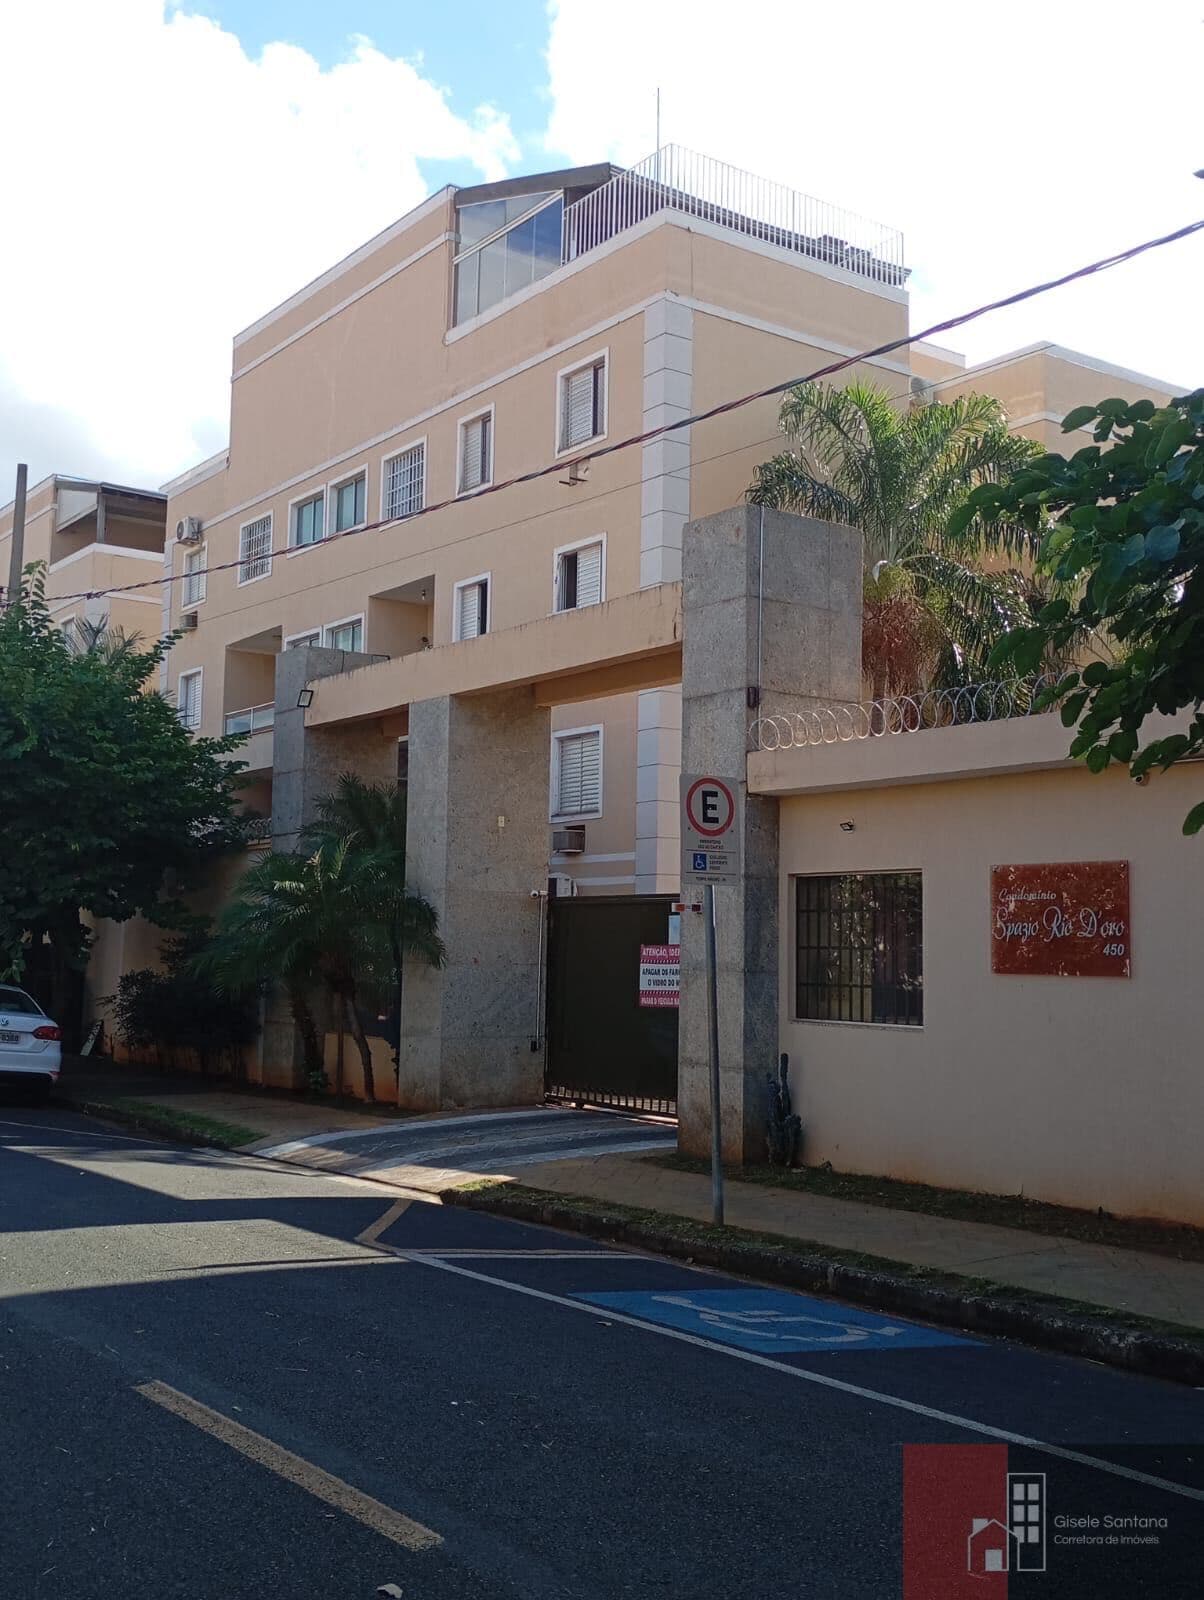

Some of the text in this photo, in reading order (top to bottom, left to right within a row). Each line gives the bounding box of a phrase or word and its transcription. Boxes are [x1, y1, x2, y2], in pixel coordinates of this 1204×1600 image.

[702, 790, 719, 824] E
[992, 906, 1039, 944] Spazio
[1043, 905, 1074, 942] Rio
[1103, 943, 1125, 956] 450
